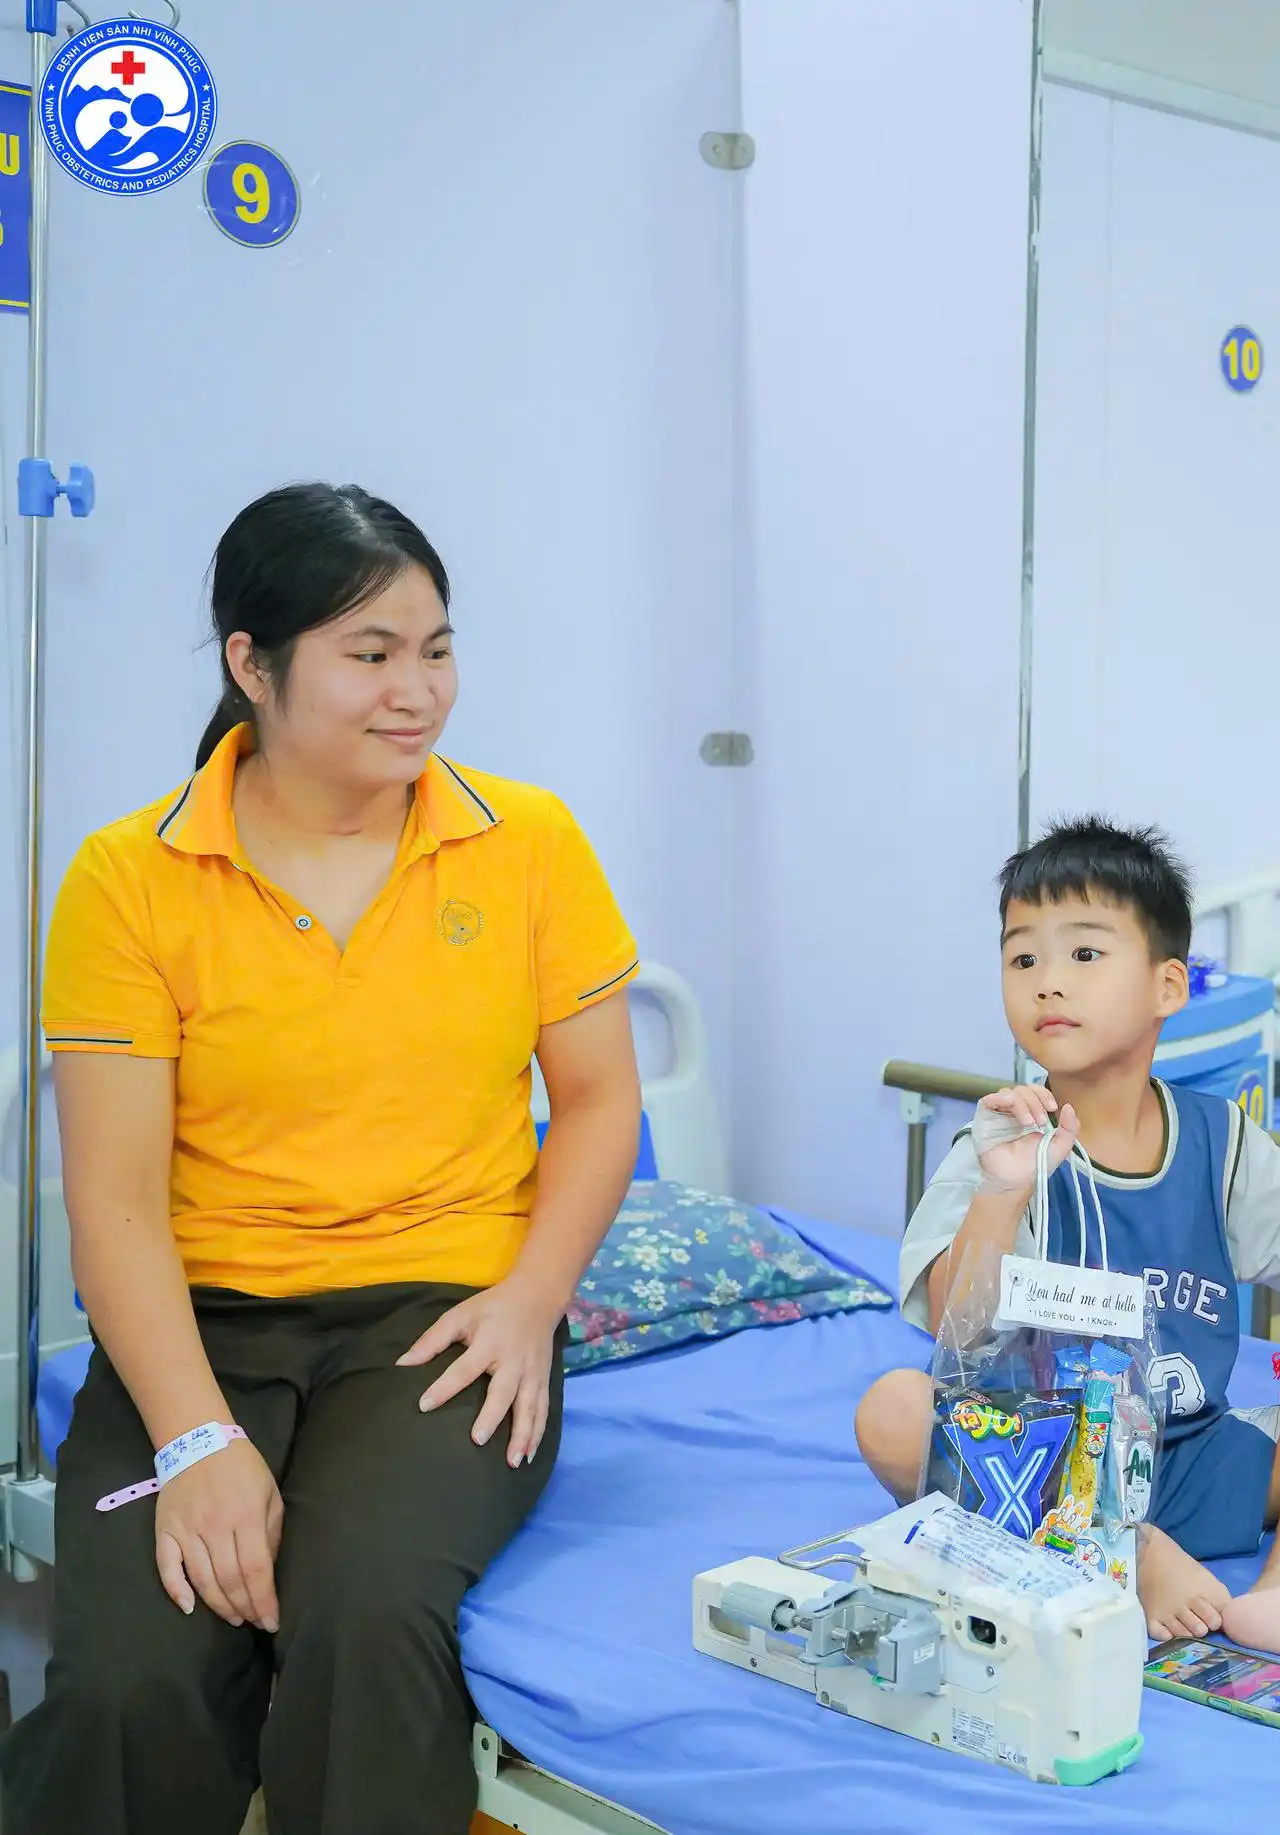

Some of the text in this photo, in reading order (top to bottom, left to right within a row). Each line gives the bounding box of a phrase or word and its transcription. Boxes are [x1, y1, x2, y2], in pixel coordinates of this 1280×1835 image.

[231, 162, 271, 224] 9
[1223, 338, 1261, 381] 10
[1025, 1278, 1137, 1313] You had me at hello
[1039, 1310, 1056, 1320] LOVE
[1058, 1313, 1076, 1322] YOU
[1143, 1267, 1228, 1326] RGE
